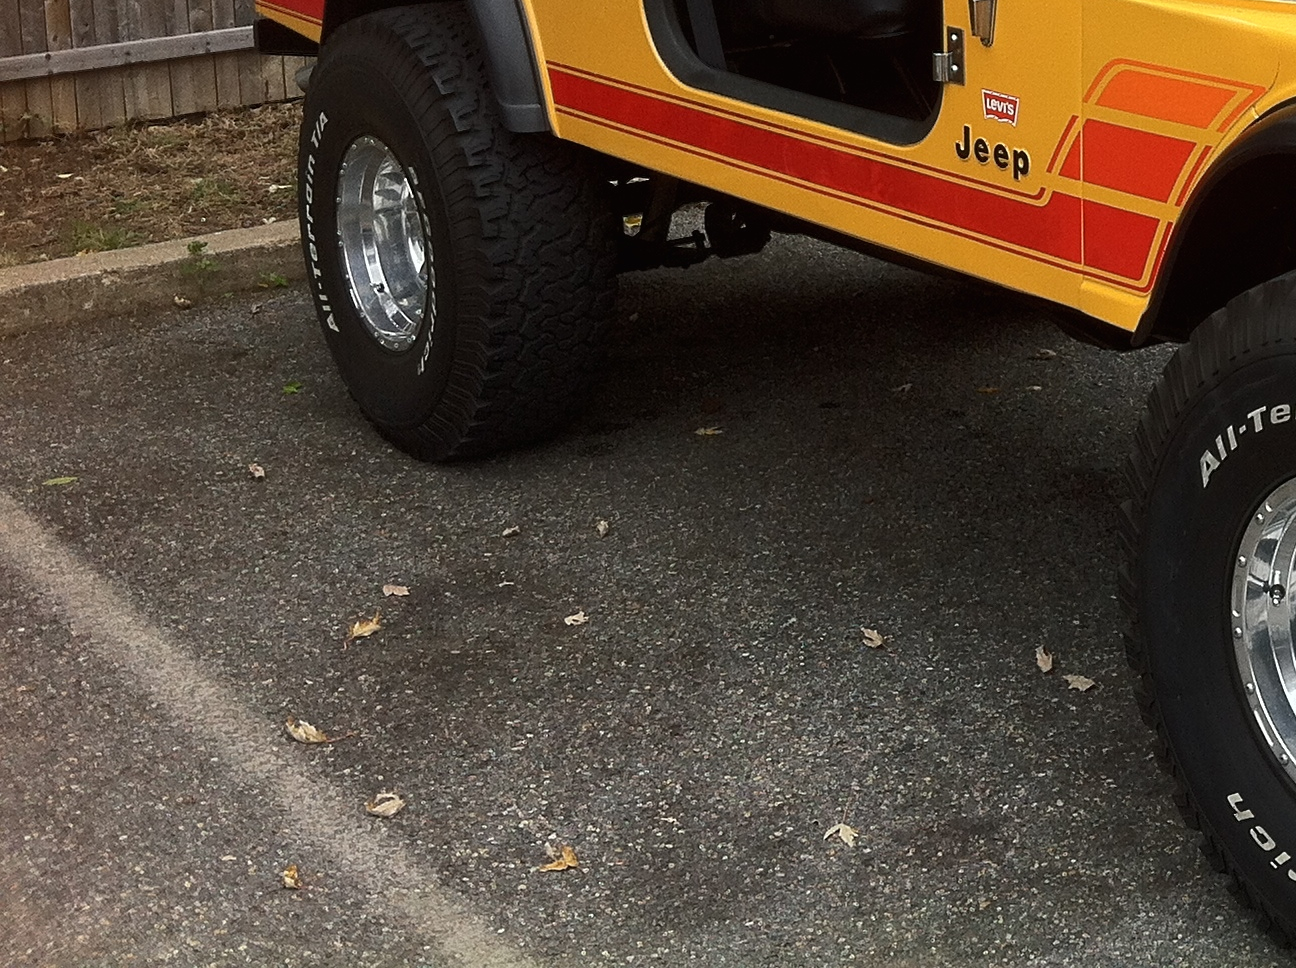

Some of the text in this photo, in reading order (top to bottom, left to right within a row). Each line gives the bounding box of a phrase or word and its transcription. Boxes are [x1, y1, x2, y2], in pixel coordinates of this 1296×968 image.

[955, 124, 1030, 180] Jeep
[305, 111, 340, 332] All-Terrain T/A
